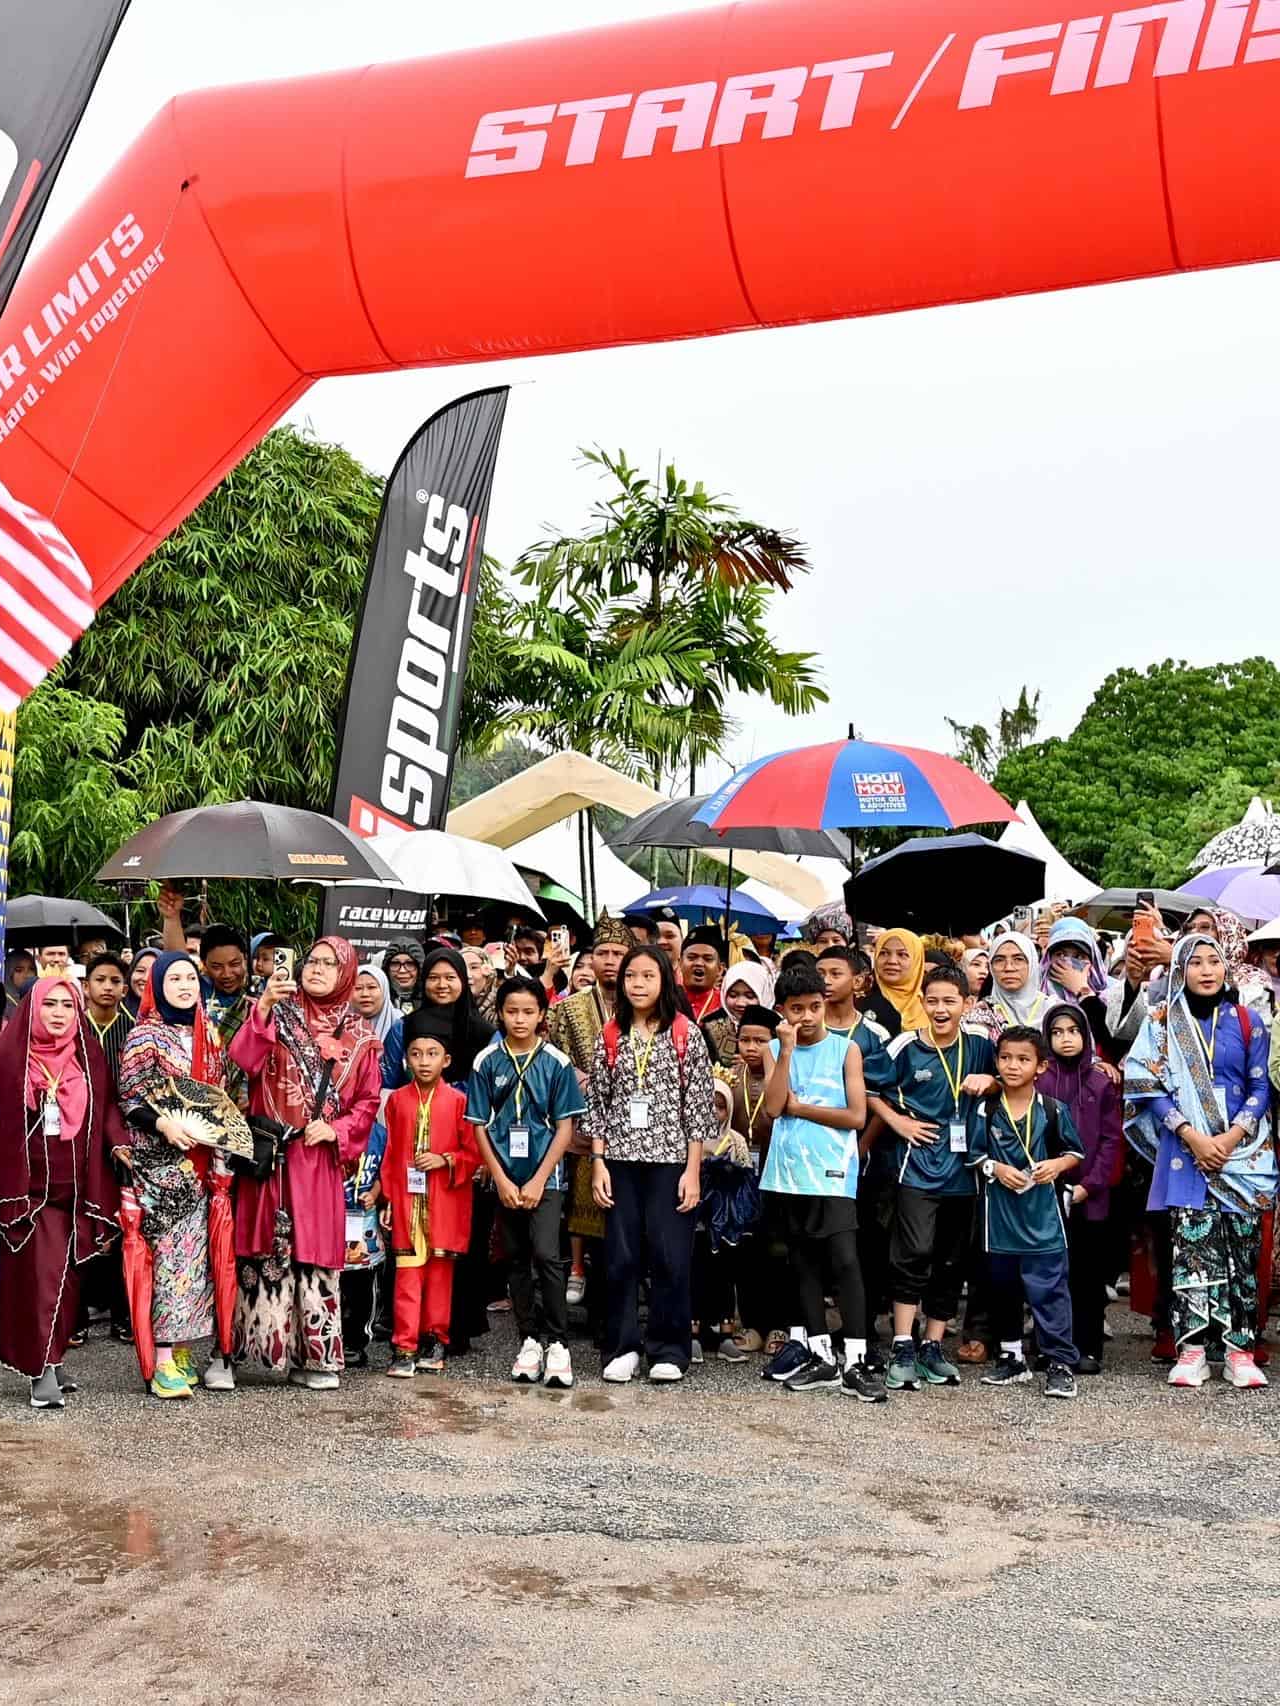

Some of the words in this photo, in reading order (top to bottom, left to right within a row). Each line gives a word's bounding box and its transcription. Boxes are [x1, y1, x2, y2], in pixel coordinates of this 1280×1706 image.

[465, 51, 894, 178] START
[23, 213, 144, 357] LIMITS
[39, 340, 81, 384] Win
[76, 243, 166, 342] Together
[854, 773, 900, 784] LIQUI
[857, 784, 902, 794] MOLY
